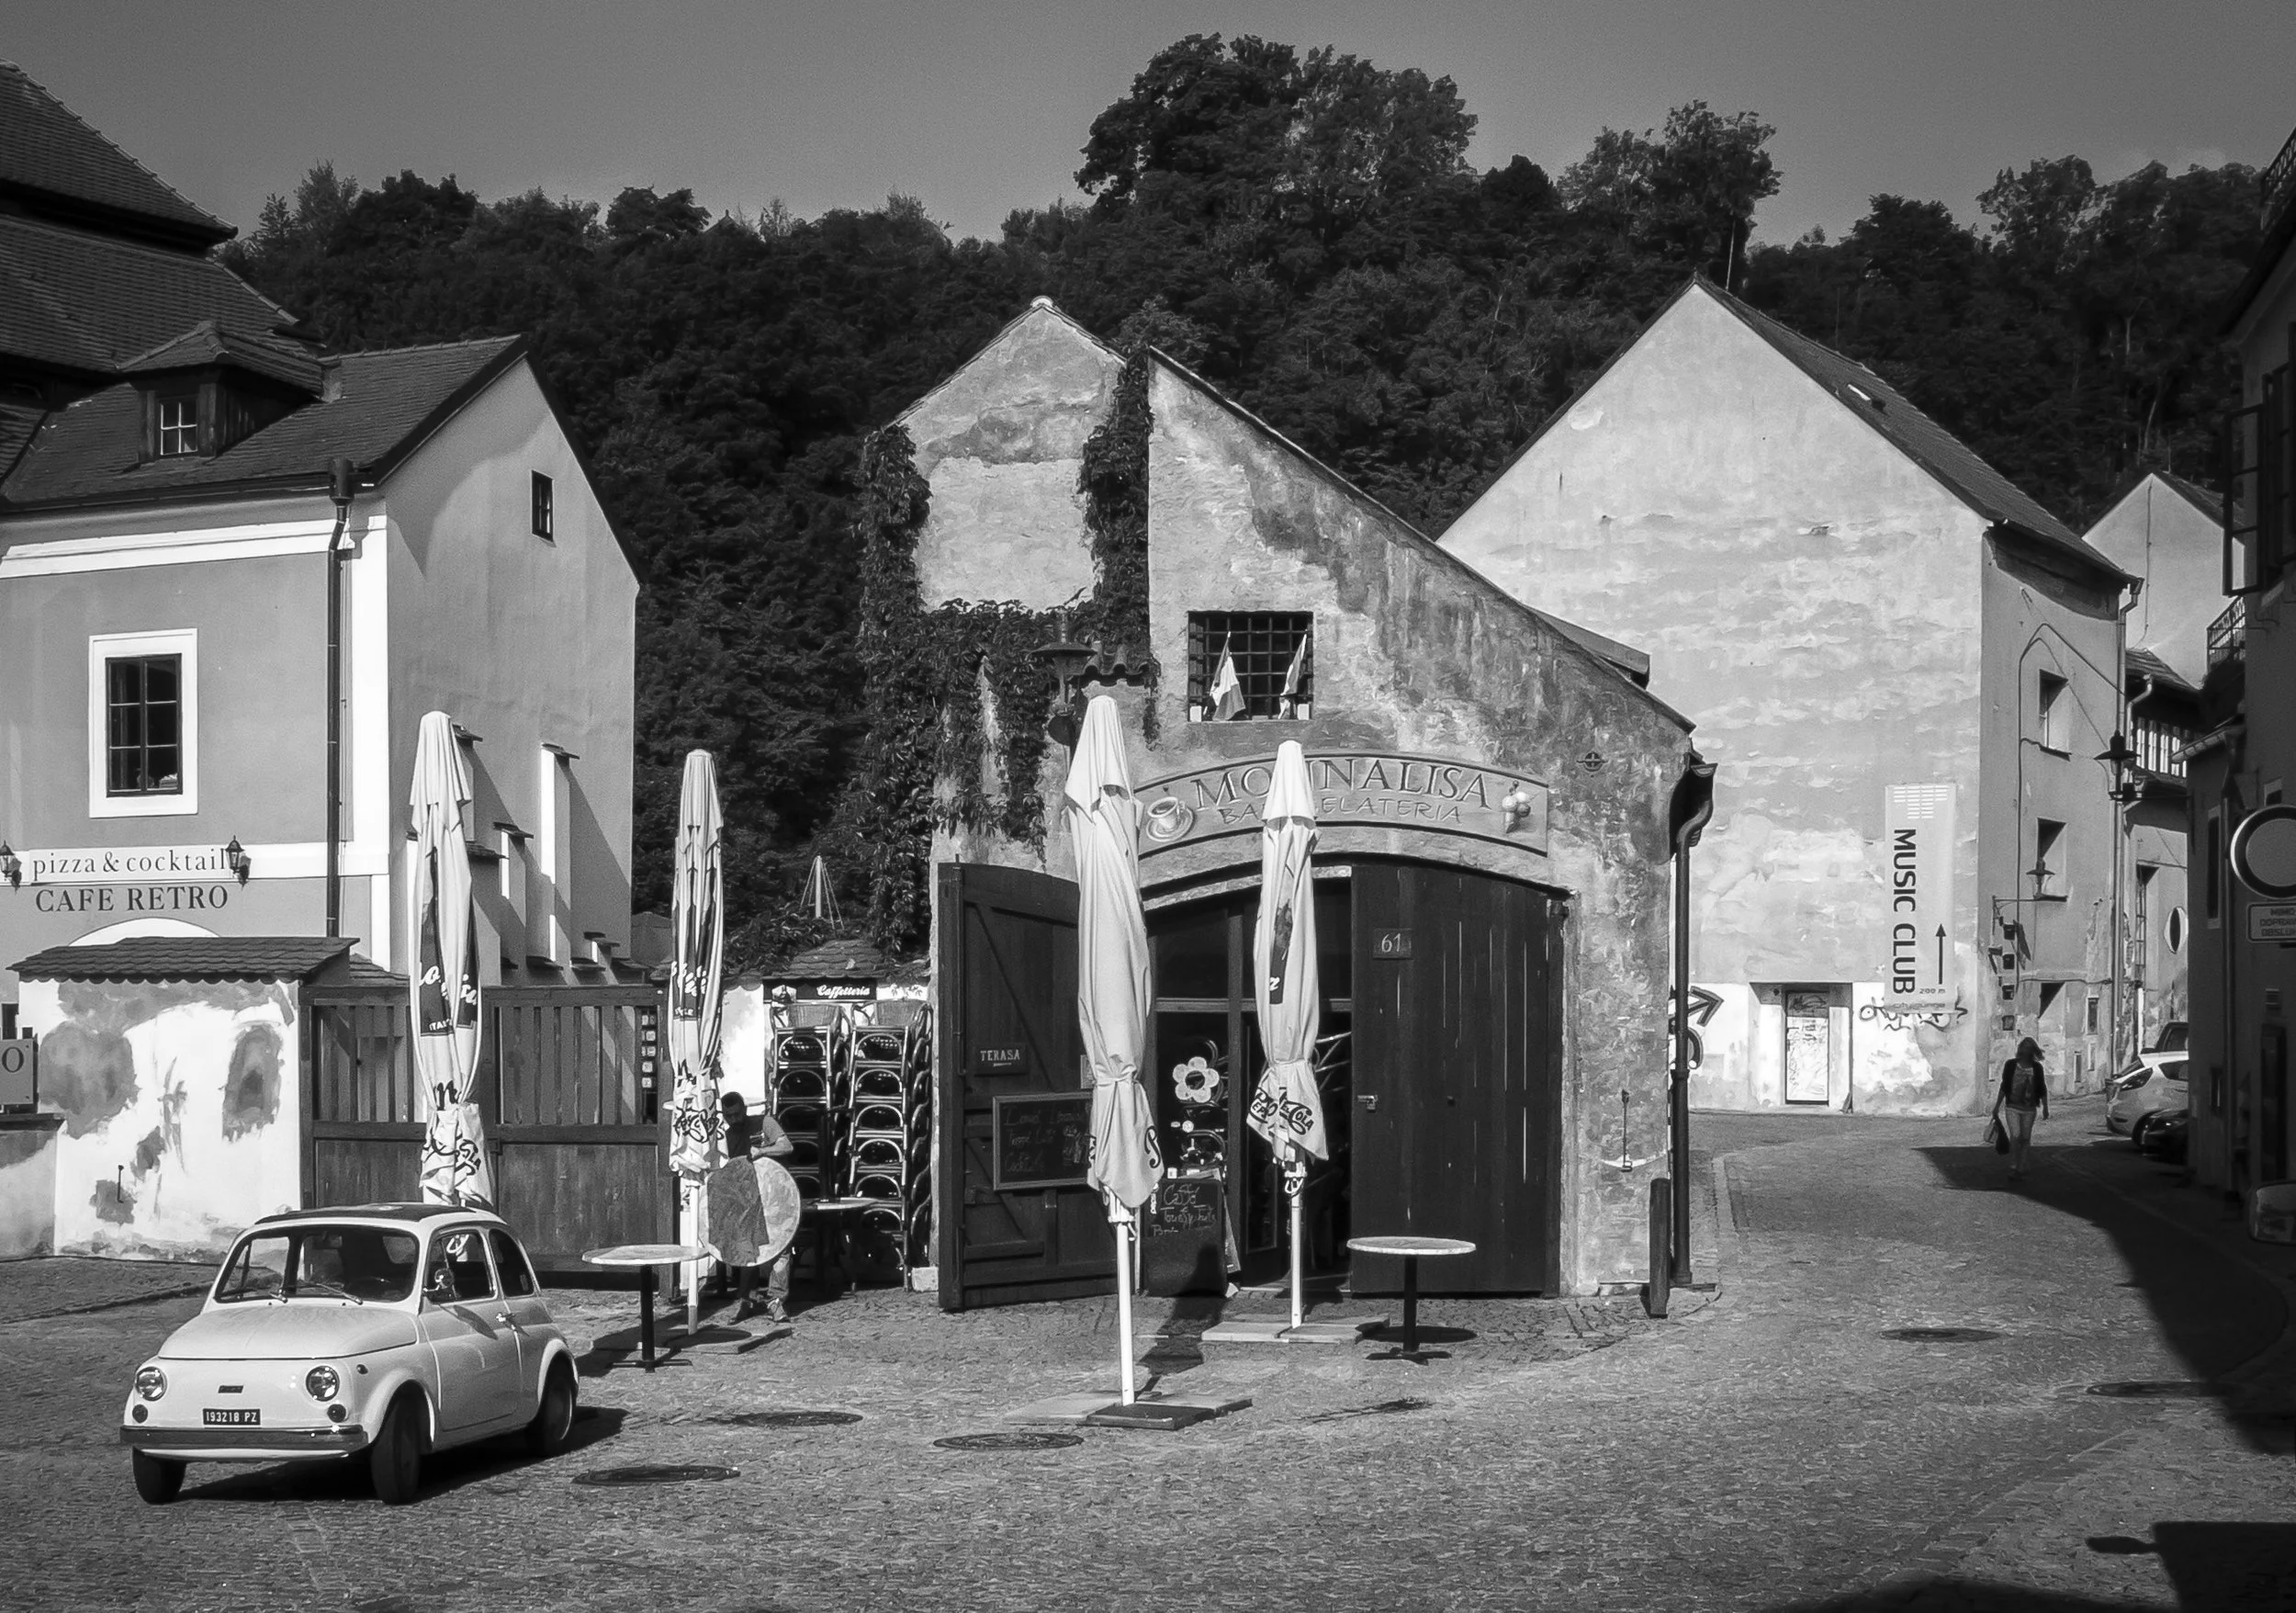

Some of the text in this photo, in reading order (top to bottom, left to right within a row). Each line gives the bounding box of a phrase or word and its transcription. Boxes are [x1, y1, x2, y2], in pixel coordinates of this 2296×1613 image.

[1190, 759, 1492, 811] MONALISA
[1217, 796, 1464, 825] BA ELATERIA
[33, 848, 226, 882] pizza & cocktail
[35, 885, 229, 912] CAFE RETRO
[1893, 829, 1917, 994] MUSIC CLUB
[1381, 932, 1401, 953] 61
[816, 985, 871, 999] Caffetteria
[980, 1049, 1021, 1062] TERASA
[244, 1412, 257, 1423] PZ
